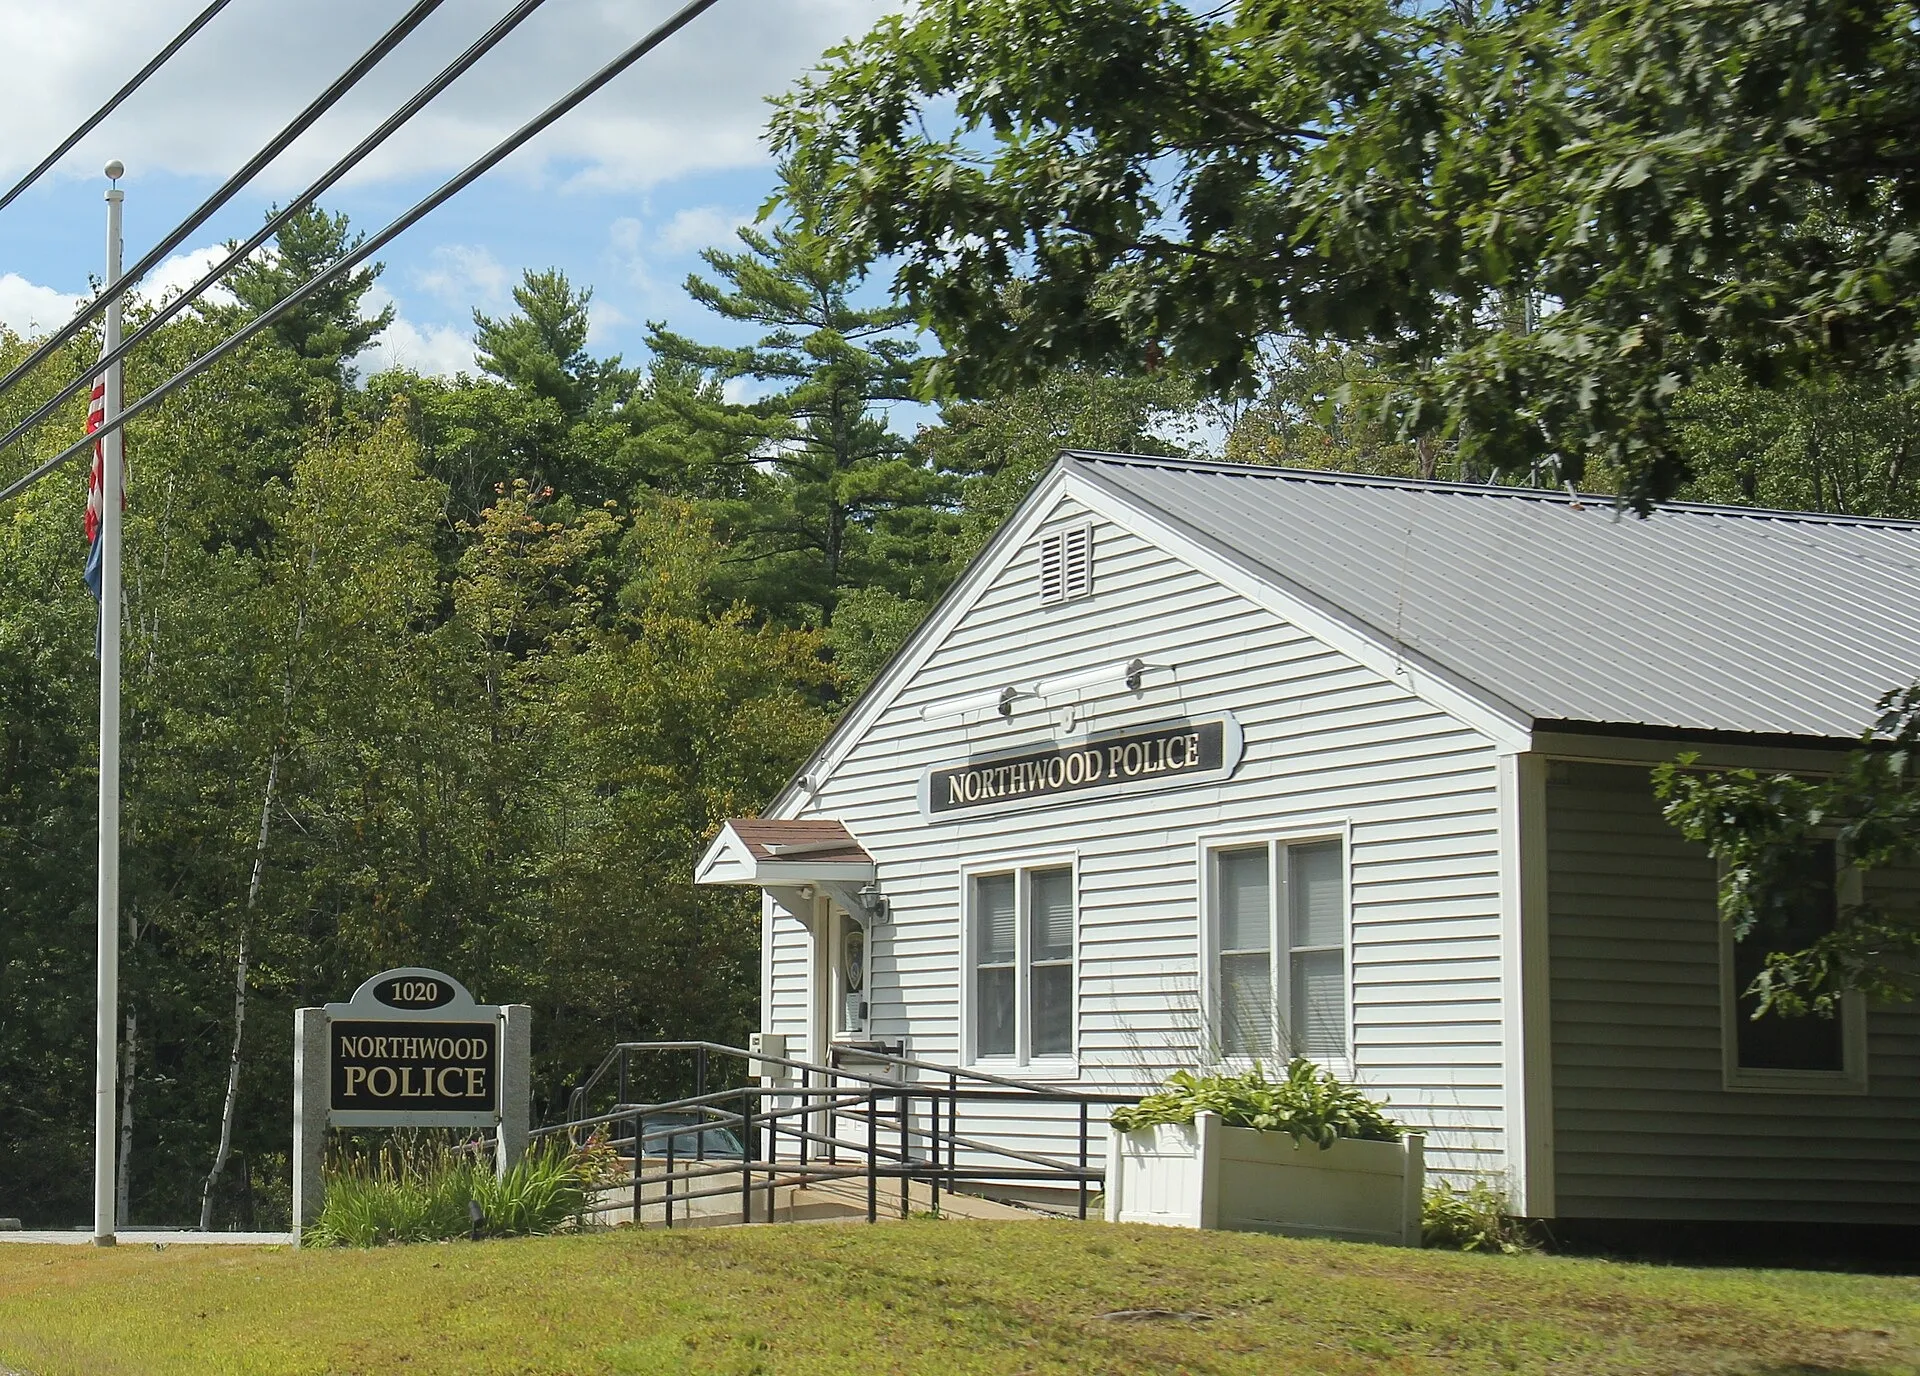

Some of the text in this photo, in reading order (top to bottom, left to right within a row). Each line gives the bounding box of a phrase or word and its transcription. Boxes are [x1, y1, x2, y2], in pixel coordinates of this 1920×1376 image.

[948, 732, 1199, 804] NORTHWOOD POLICE
[391, 982, 438, 1001] 1020
[340, 1036, 488, 1060] NORTHWOOD
[343, 1066, 486, 1097] POLICE
